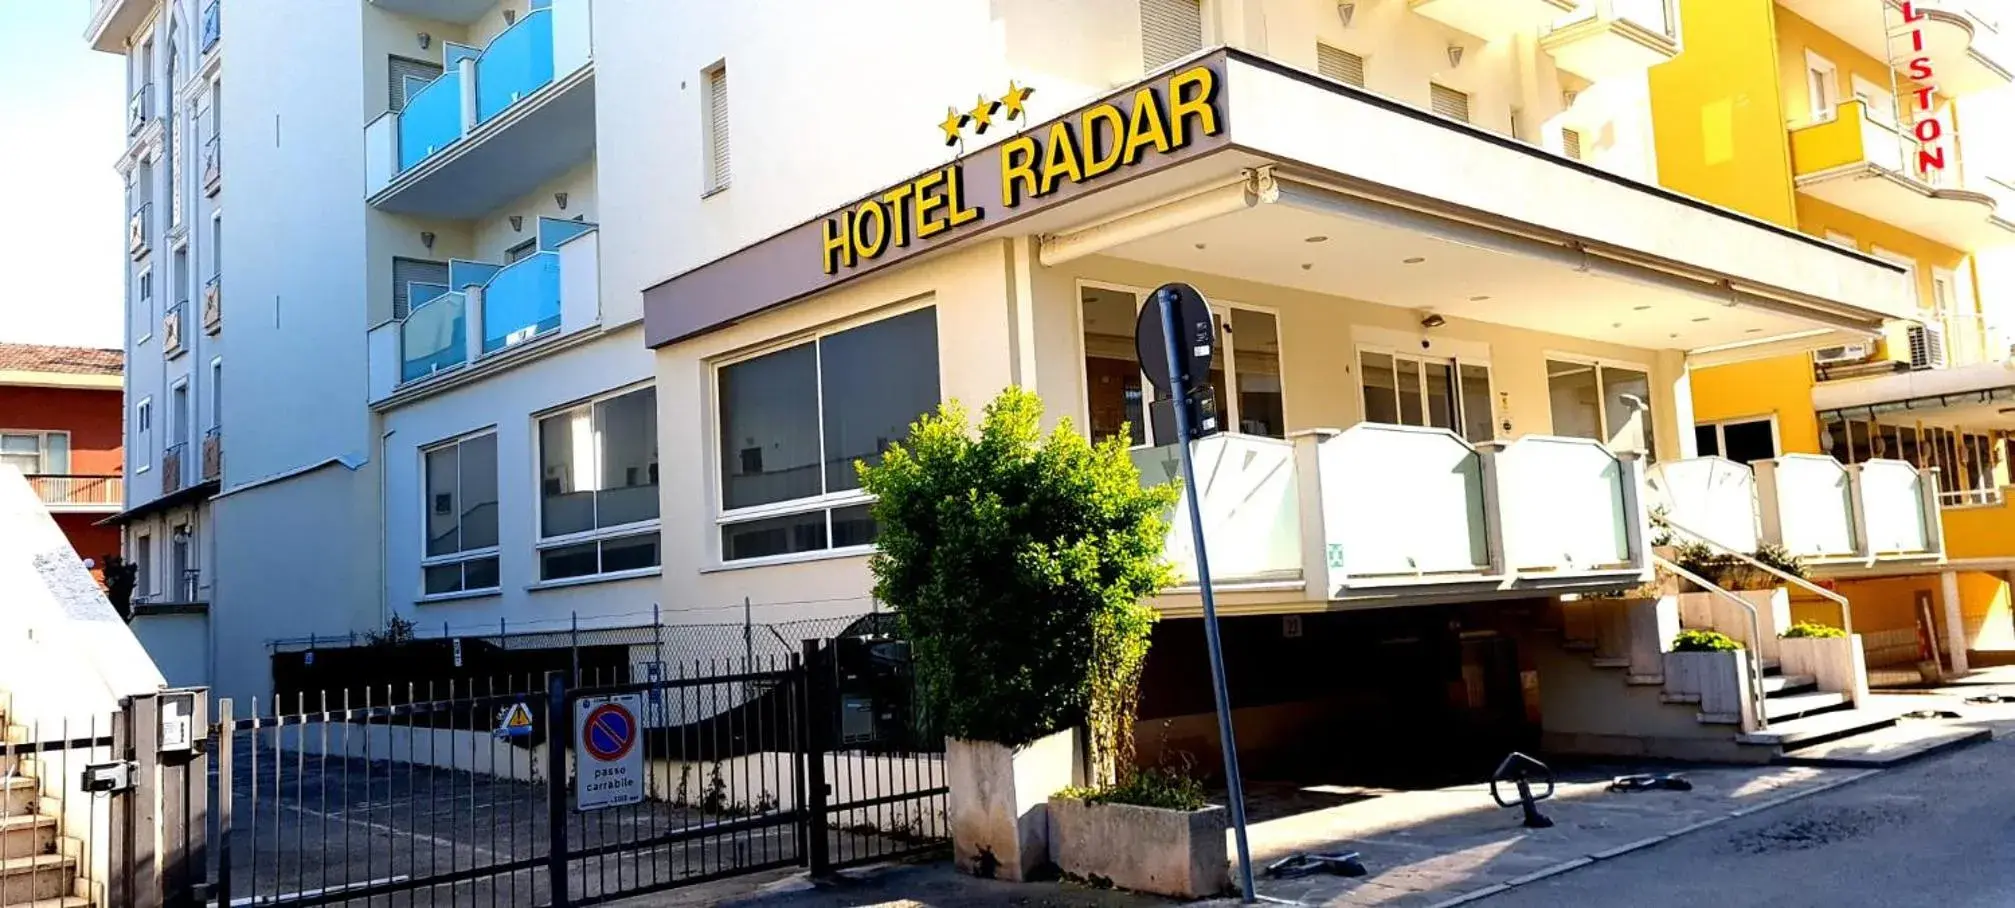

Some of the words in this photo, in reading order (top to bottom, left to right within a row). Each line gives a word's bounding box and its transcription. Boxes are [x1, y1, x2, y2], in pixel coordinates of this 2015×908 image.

[1902, 1, 1945, 173] LISTON
[822, 166, 980, 274] HOTEL
[1001, 64, 1219, 207] RADAR
[586, 778, 634, 792] carrabile
[594, 767, 626, 780] passo
